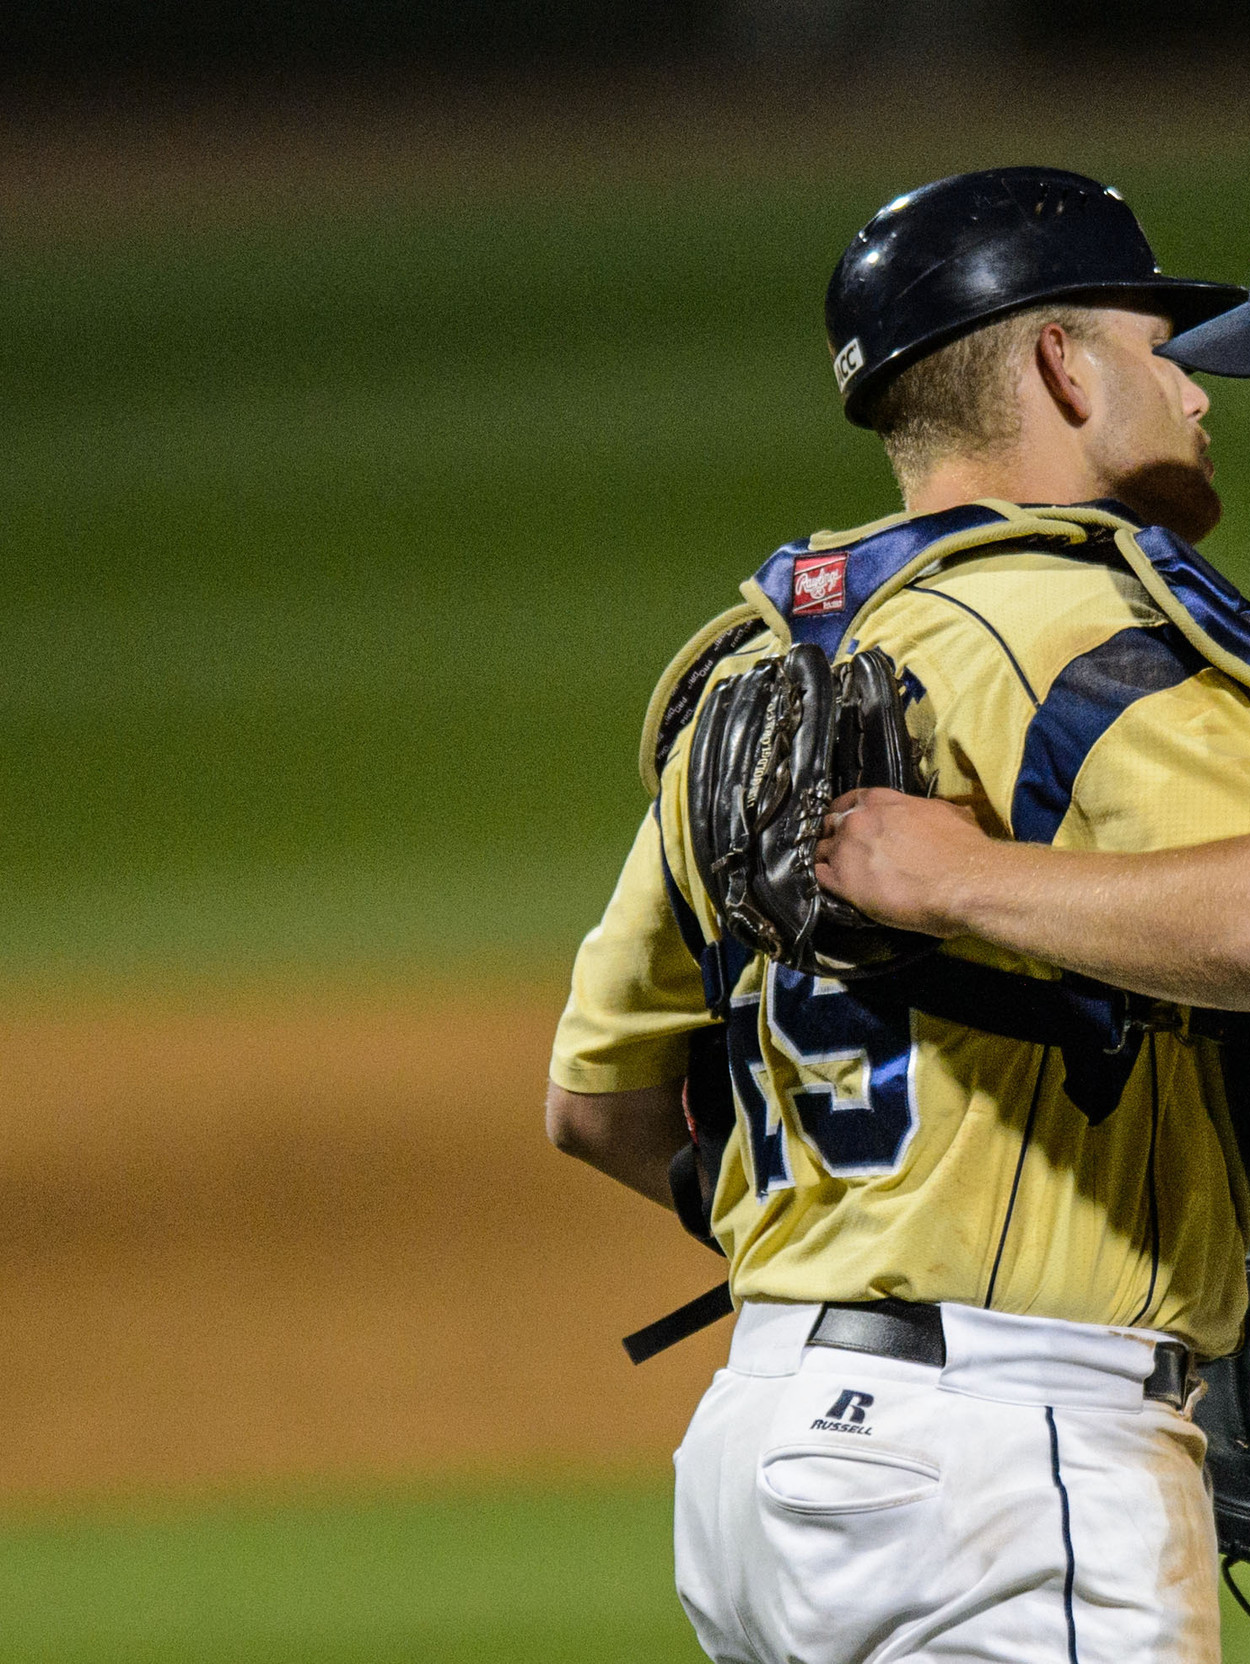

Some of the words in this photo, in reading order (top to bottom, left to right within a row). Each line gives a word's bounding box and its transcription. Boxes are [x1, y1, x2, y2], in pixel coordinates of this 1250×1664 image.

[795, 567, 842, 599] Rawlings
[698, 659, 714, 678] PRO
[825, 1389, 875, 1425] R
[809, 1419, 873, 1436] RUSSELL
